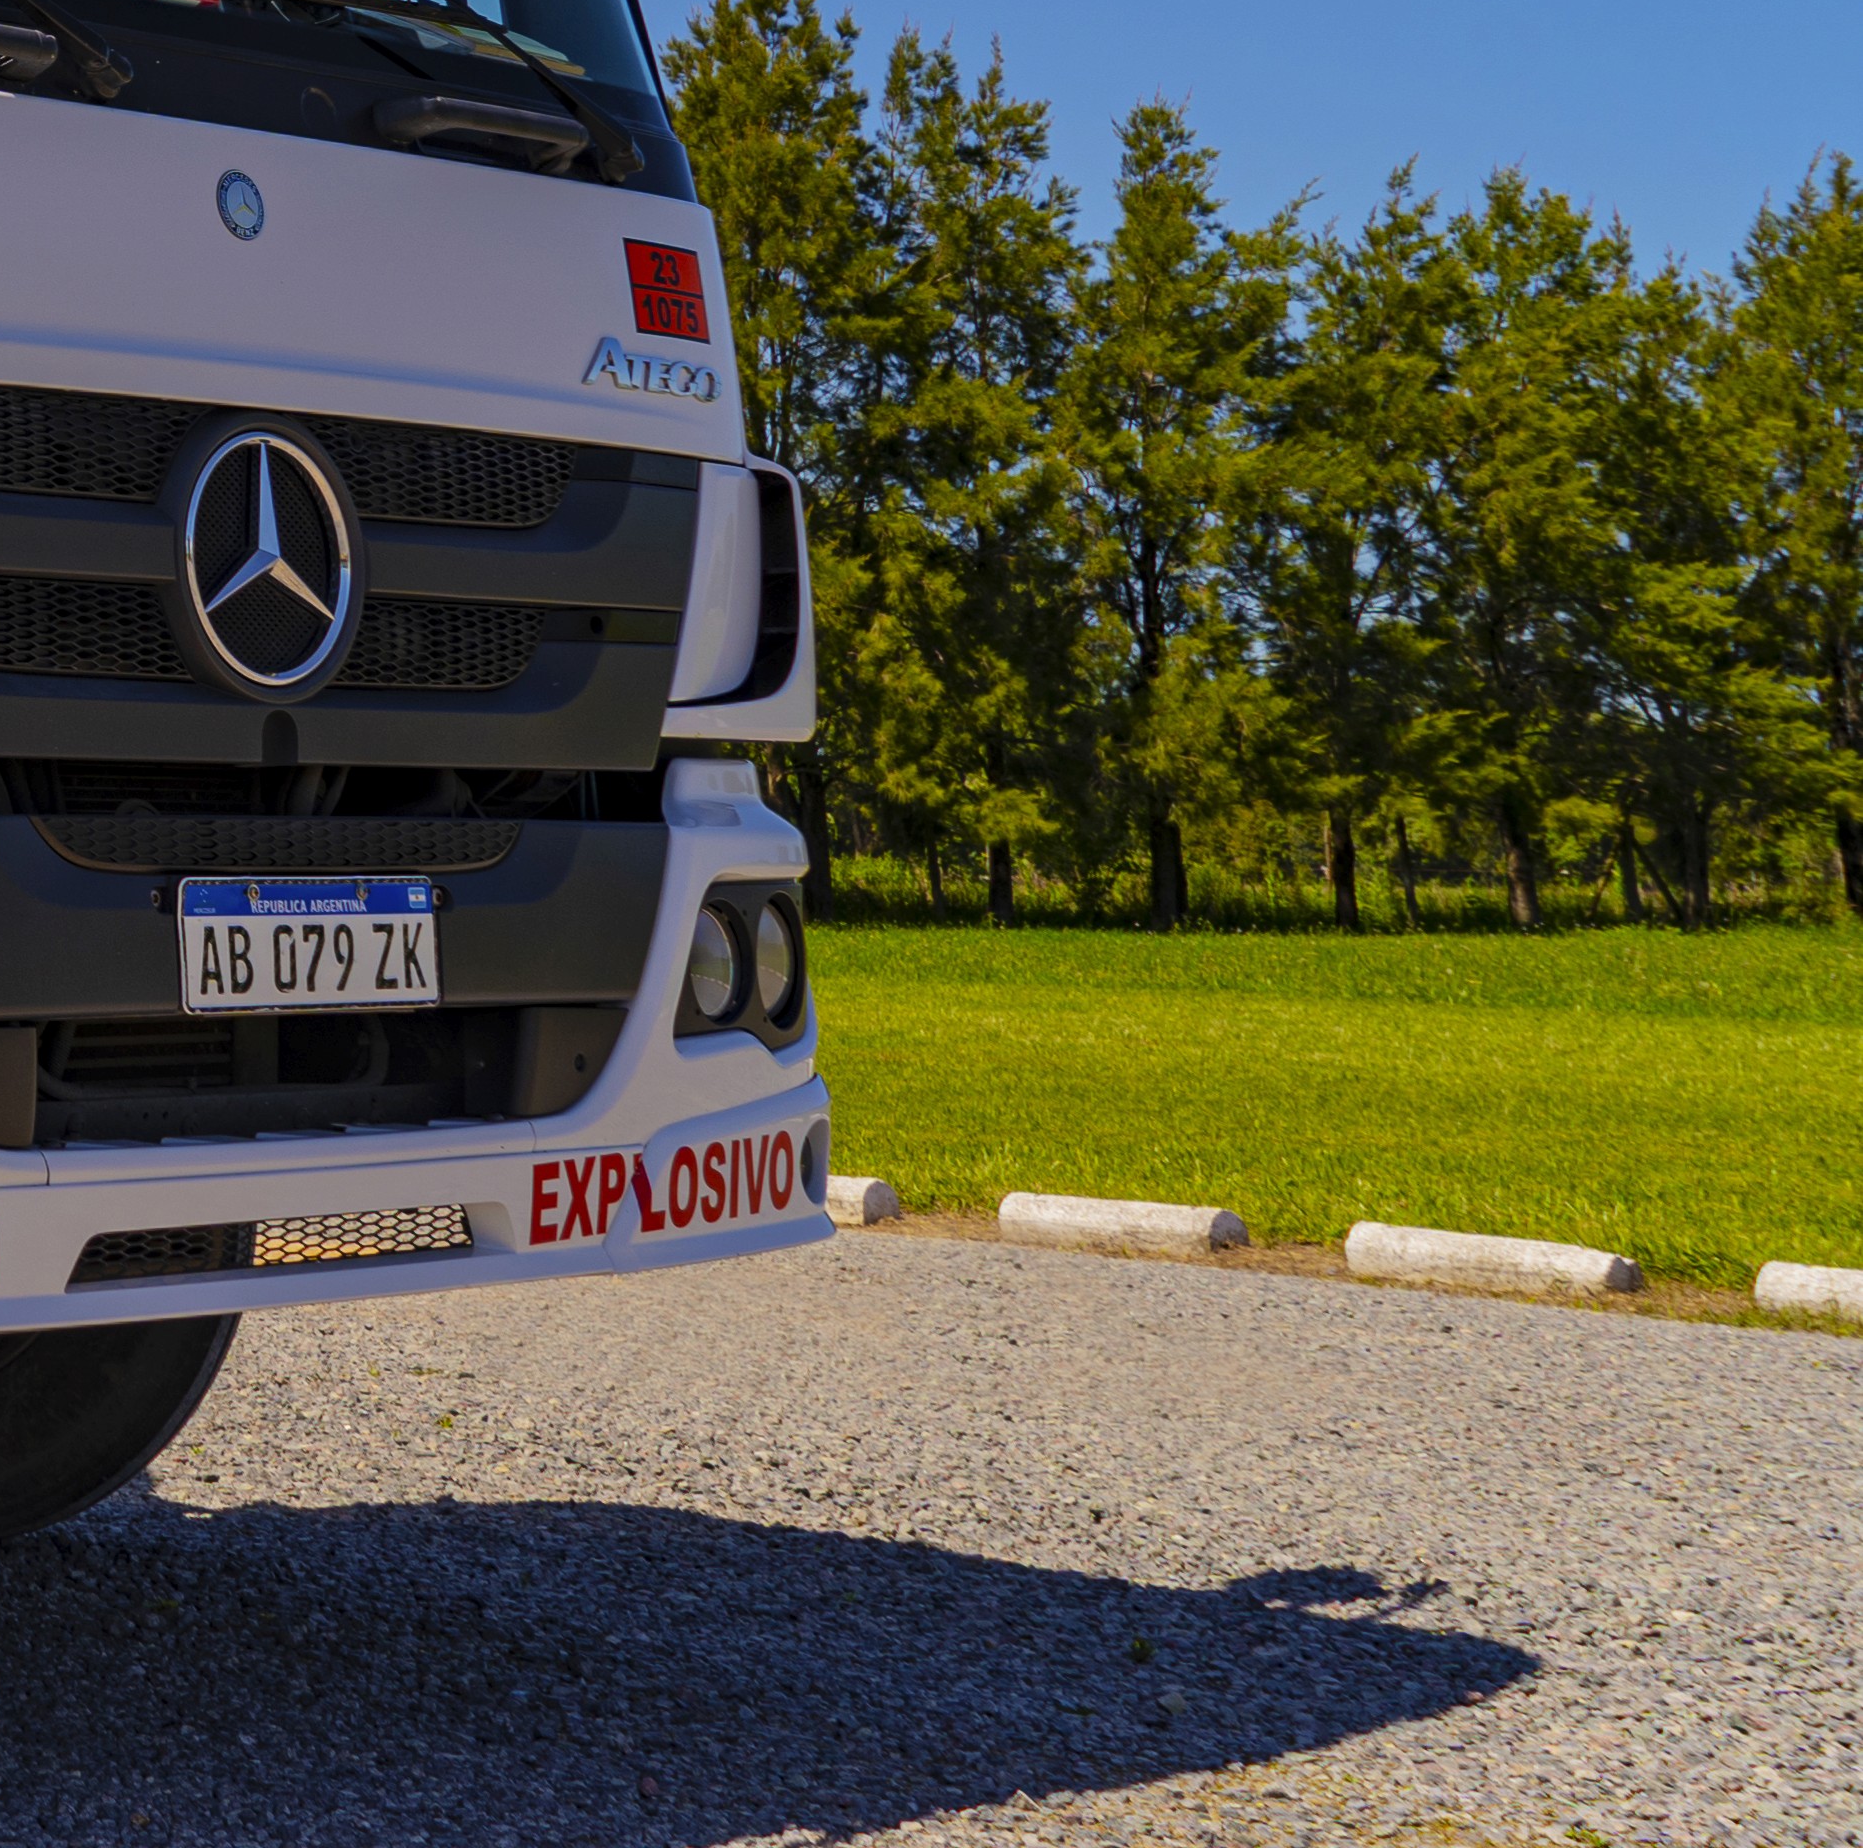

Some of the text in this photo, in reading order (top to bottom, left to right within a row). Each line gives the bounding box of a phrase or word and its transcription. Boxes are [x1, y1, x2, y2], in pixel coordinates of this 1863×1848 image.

[650, 252, 681, 287] 23
[642, 294, 699, 333] 1075
[310, 899, 367, 913] ARGENTINA
[200, 922, 427, 994] AB 079 ZK
[529, 1130, 794, 1246] EXPLOSIVO
